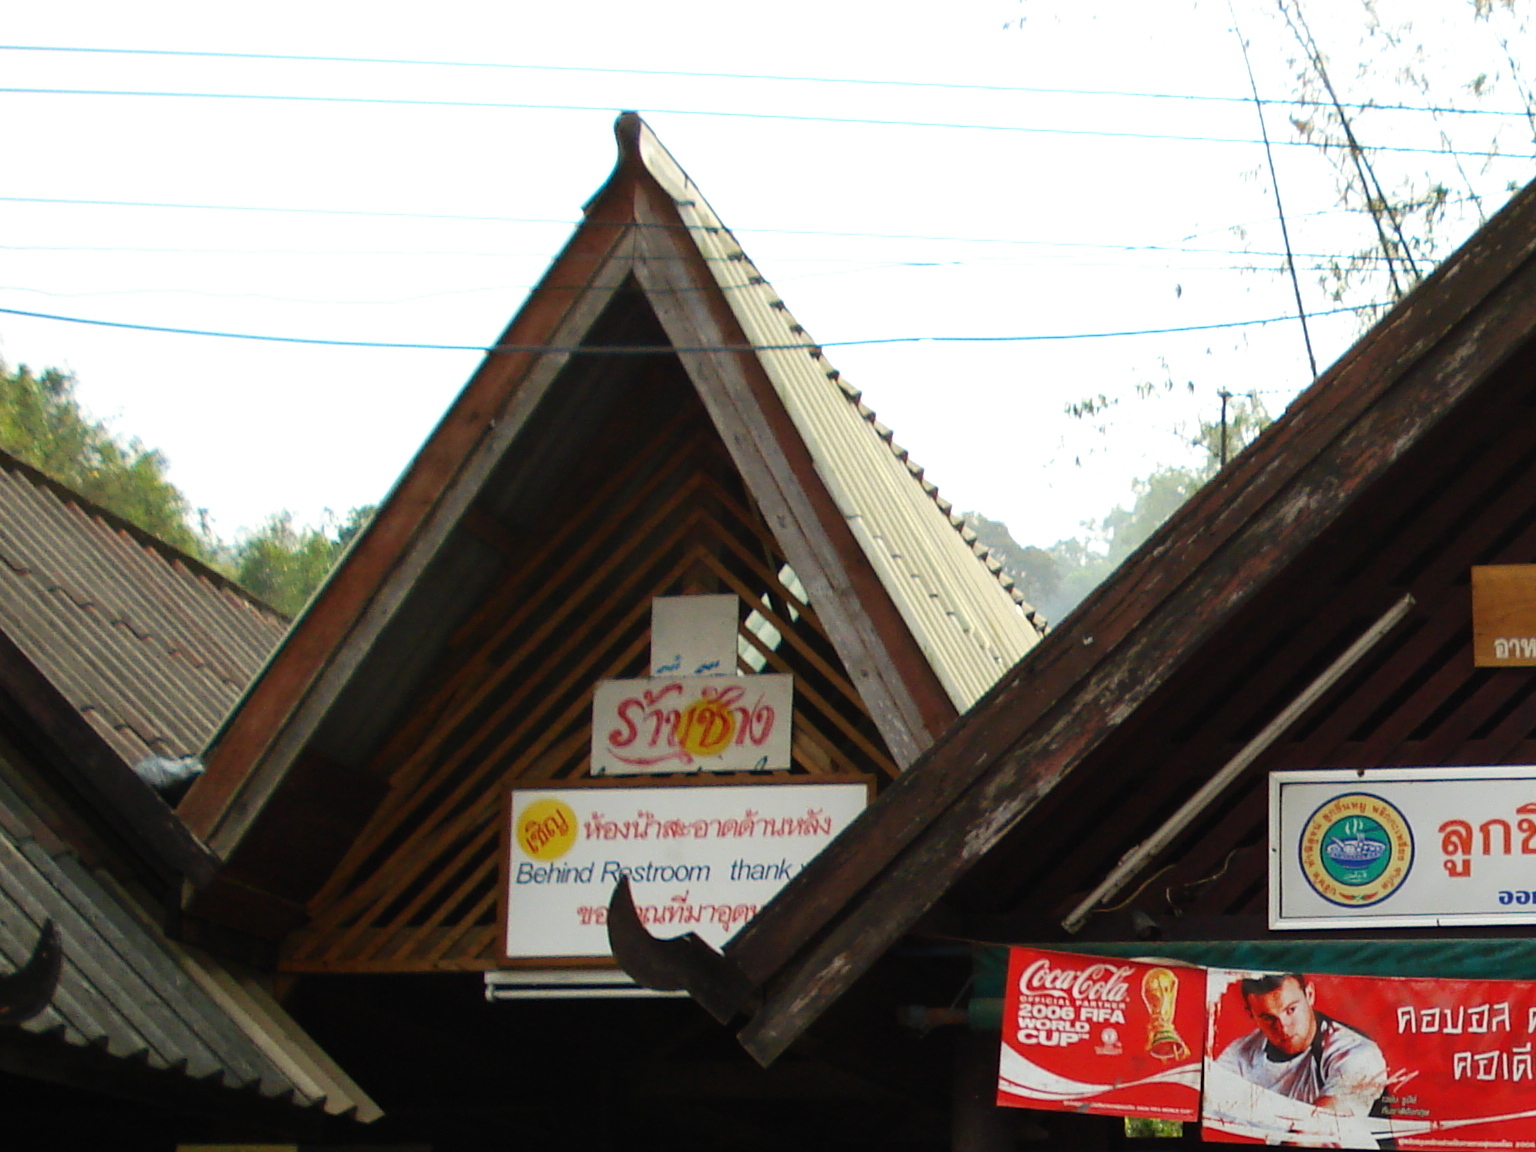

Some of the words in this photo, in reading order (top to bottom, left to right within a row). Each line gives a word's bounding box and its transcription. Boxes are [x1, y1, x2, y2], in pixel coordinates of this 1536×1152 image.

[516, 861, 595, 885] Behind
[601, 862, 711, 885] Restroom
[731, 858, 793, 882] thank
[1019, 957, 1137, 1002] Coca-Cola
[1018, 1003, 1075, 1020] 2006
[1080, 1006, 1126, 1024] FIFA
[1018, 1017, 1091, 1033] WORLD
[1397, 1003, 1512, 1036] คอบอล
